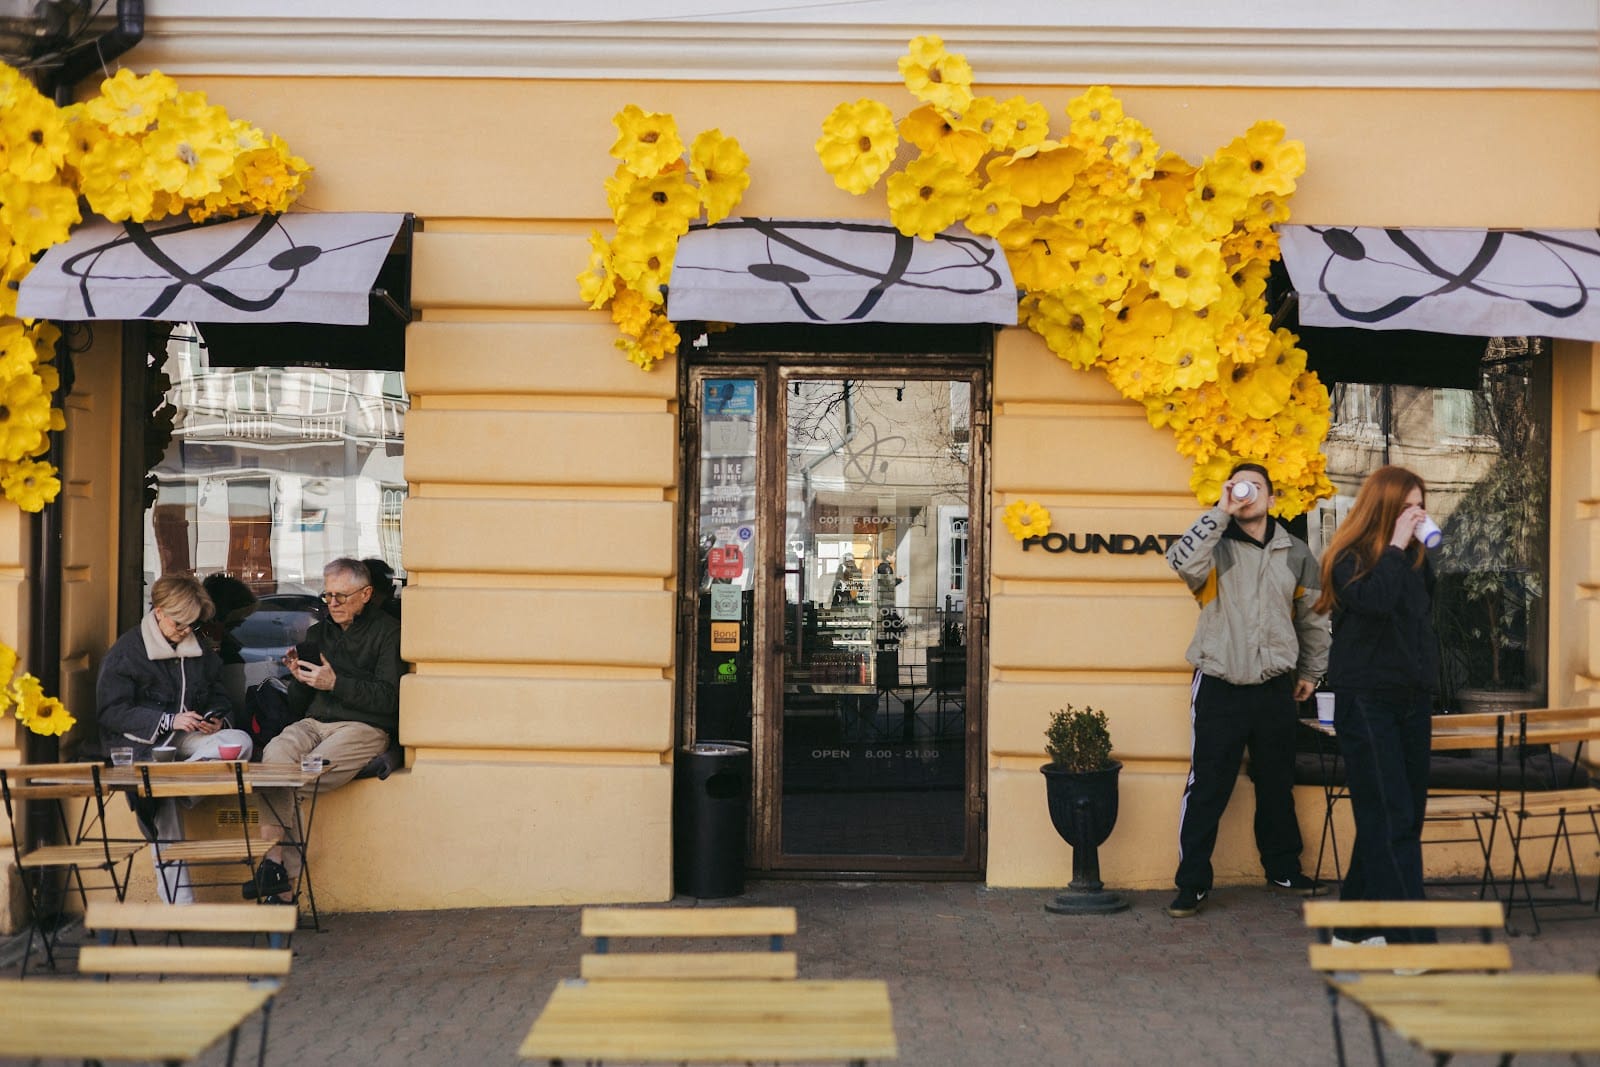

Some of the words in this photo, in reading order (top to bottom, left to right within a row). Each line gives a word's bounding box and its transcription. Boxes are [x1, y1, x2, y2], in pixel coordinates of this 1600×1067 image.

[862, 516, 923, 524] ROASTE
[812, 750, 850, 759] OPEN
[865, 750, 892, 759] 8.00
[905, 750, 940, 759] 21.00
